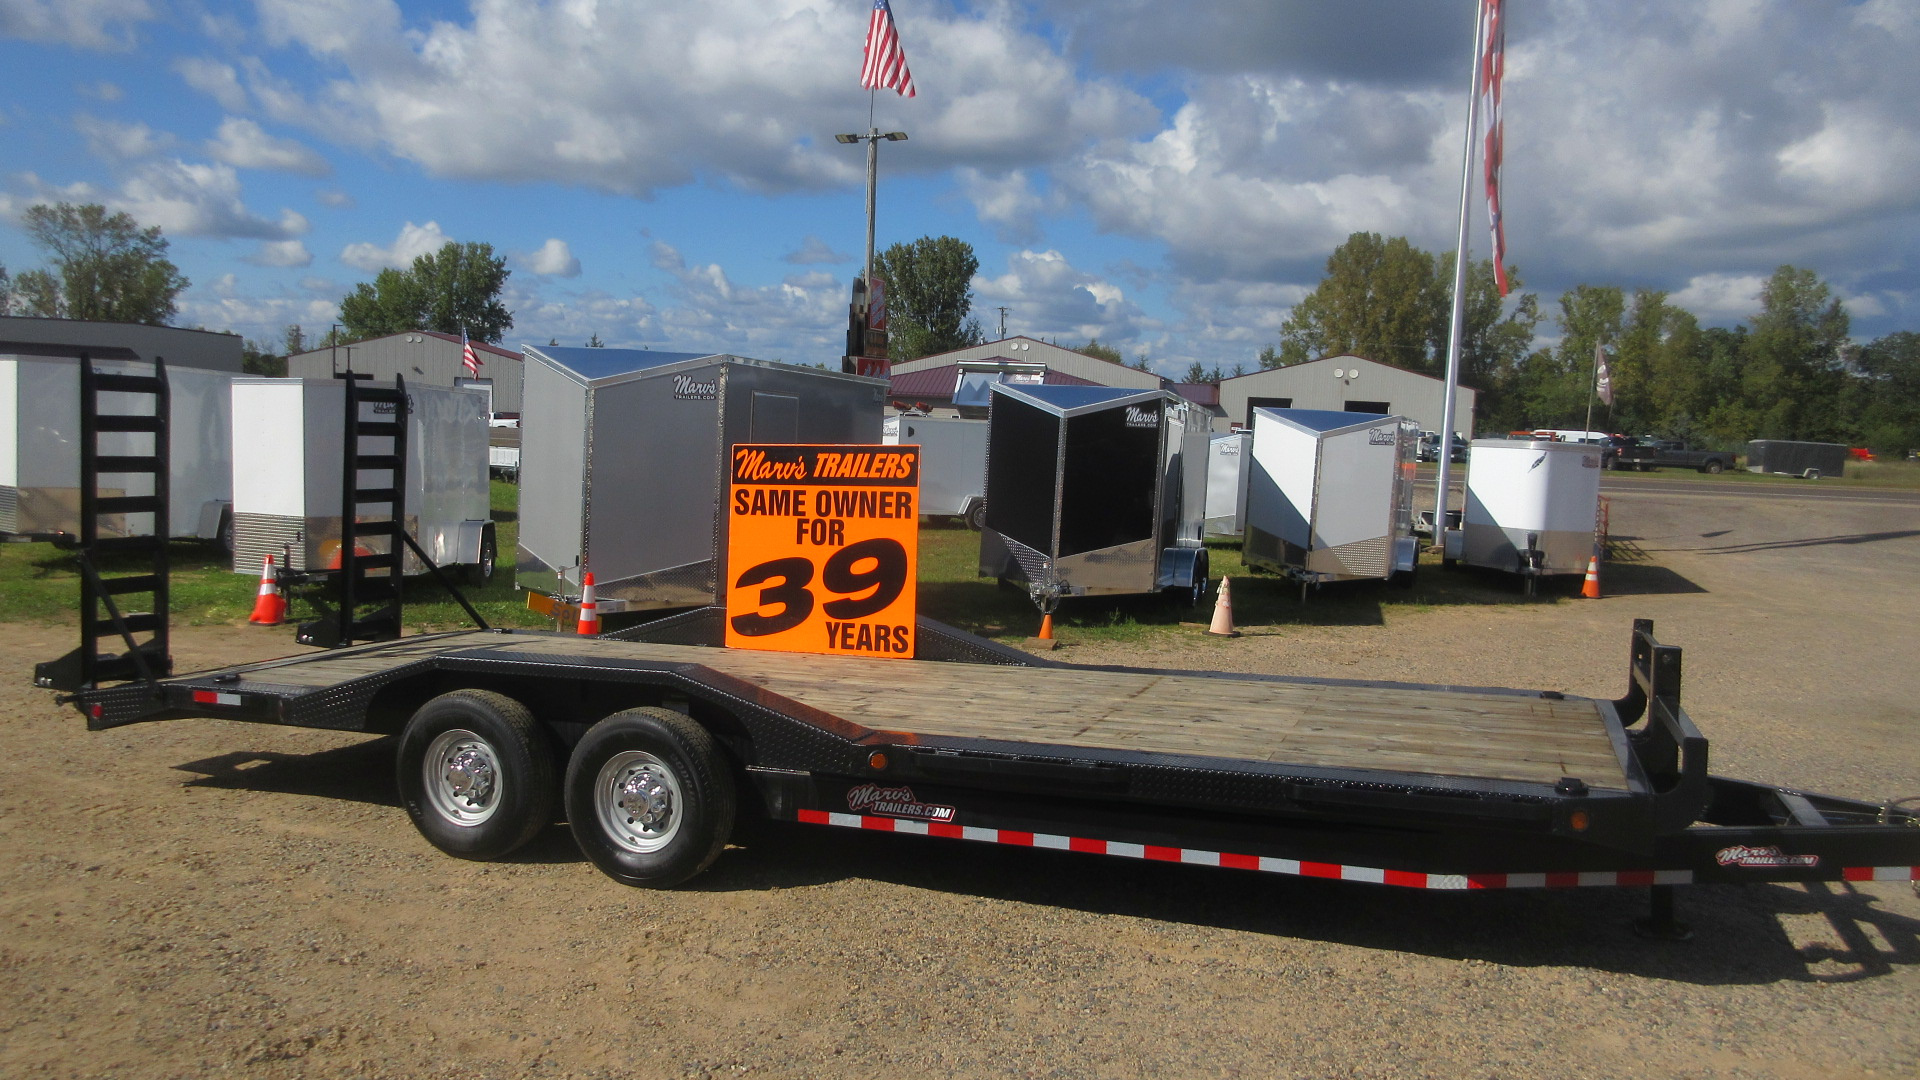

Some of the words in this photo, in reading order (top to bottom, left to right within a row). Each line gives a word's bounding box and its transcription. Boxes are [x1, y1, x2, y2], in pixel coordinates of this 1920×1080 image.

[673, 374, 716, 394] Marv's
[1125, 406, 1158, 423] Marv's
[1369, 428, 1395, 442] Marv's
[735, 449, 807, 480] Marv's
[813, 453, 914, 479] TRAILERS
[735, 489, 807, 516] SAME
[816, 490, 912, 519] OWNER
[796, 518, 845, 546] FOR
[730, 538, 907, 637] 39
[551, 602, 579, 623] Sol
[825, 622, 909, 653] YEARS
[849, 786, 912, 807] Marv's
[873, 801, 952, 818] TRAILERS.COM
[1717, 846, 1777, 863] Marv's
[1741, 856, 1815, 865] TRAILERS.COM
